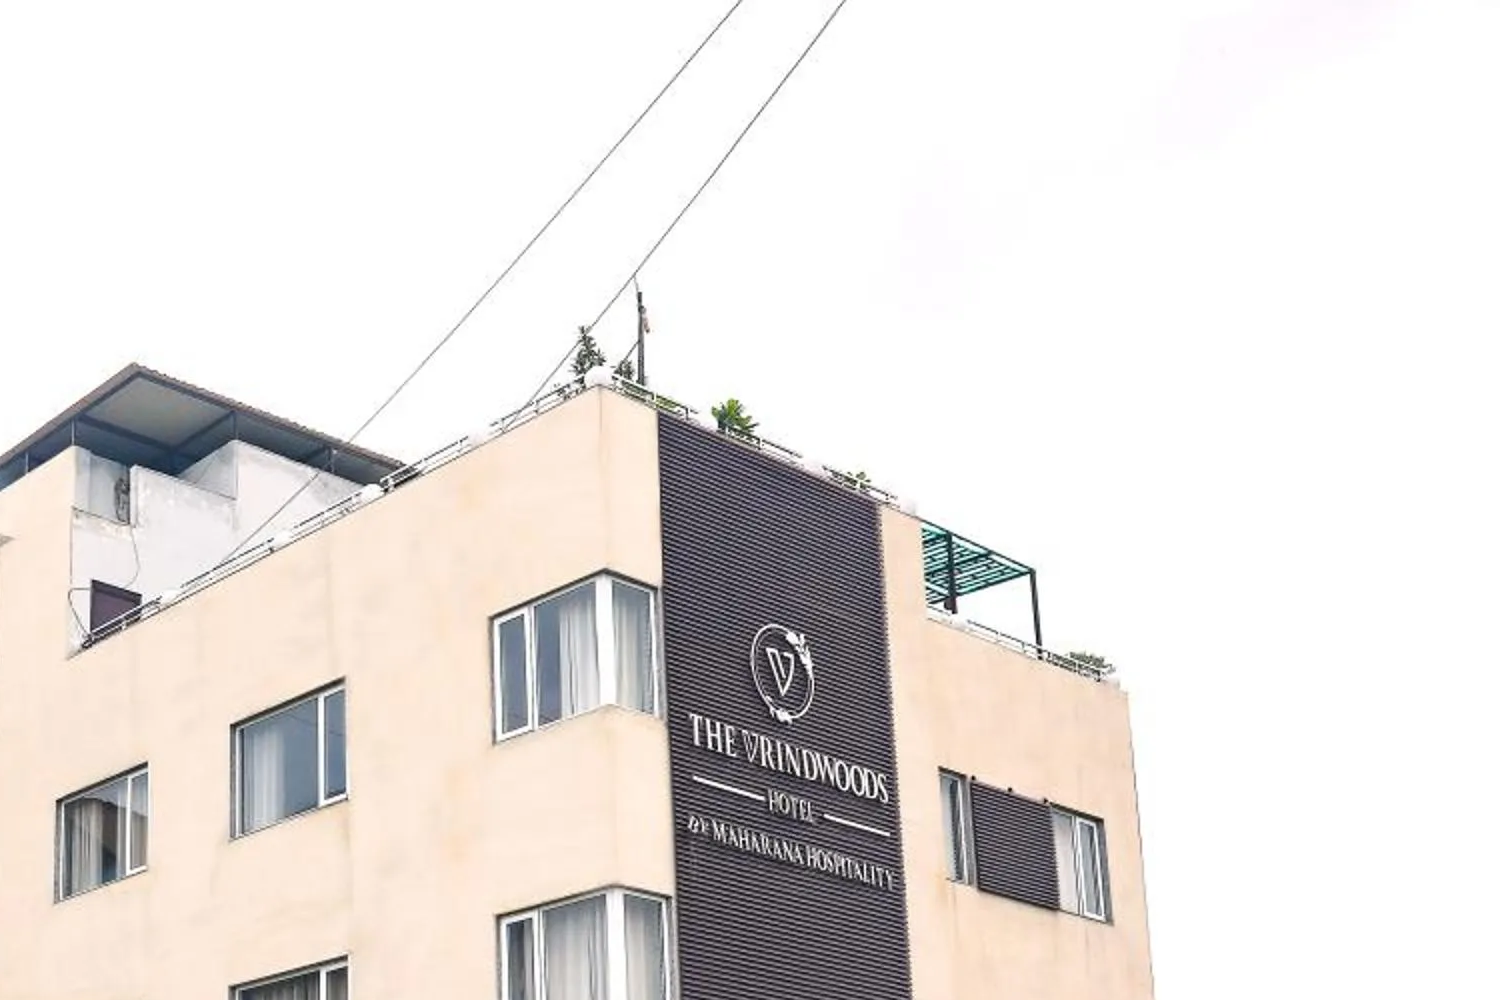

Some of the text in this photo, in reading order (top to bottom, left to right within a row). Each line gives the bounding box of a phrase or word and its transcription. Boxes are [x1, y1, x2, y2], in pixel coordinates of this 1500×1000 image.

[689, 712, 889, 803] THE VRINDWOODS
[767, 788, 814, 823] HOTEL
[688, 815, 895, 890] BY MAHARANA HOSPITALITY
